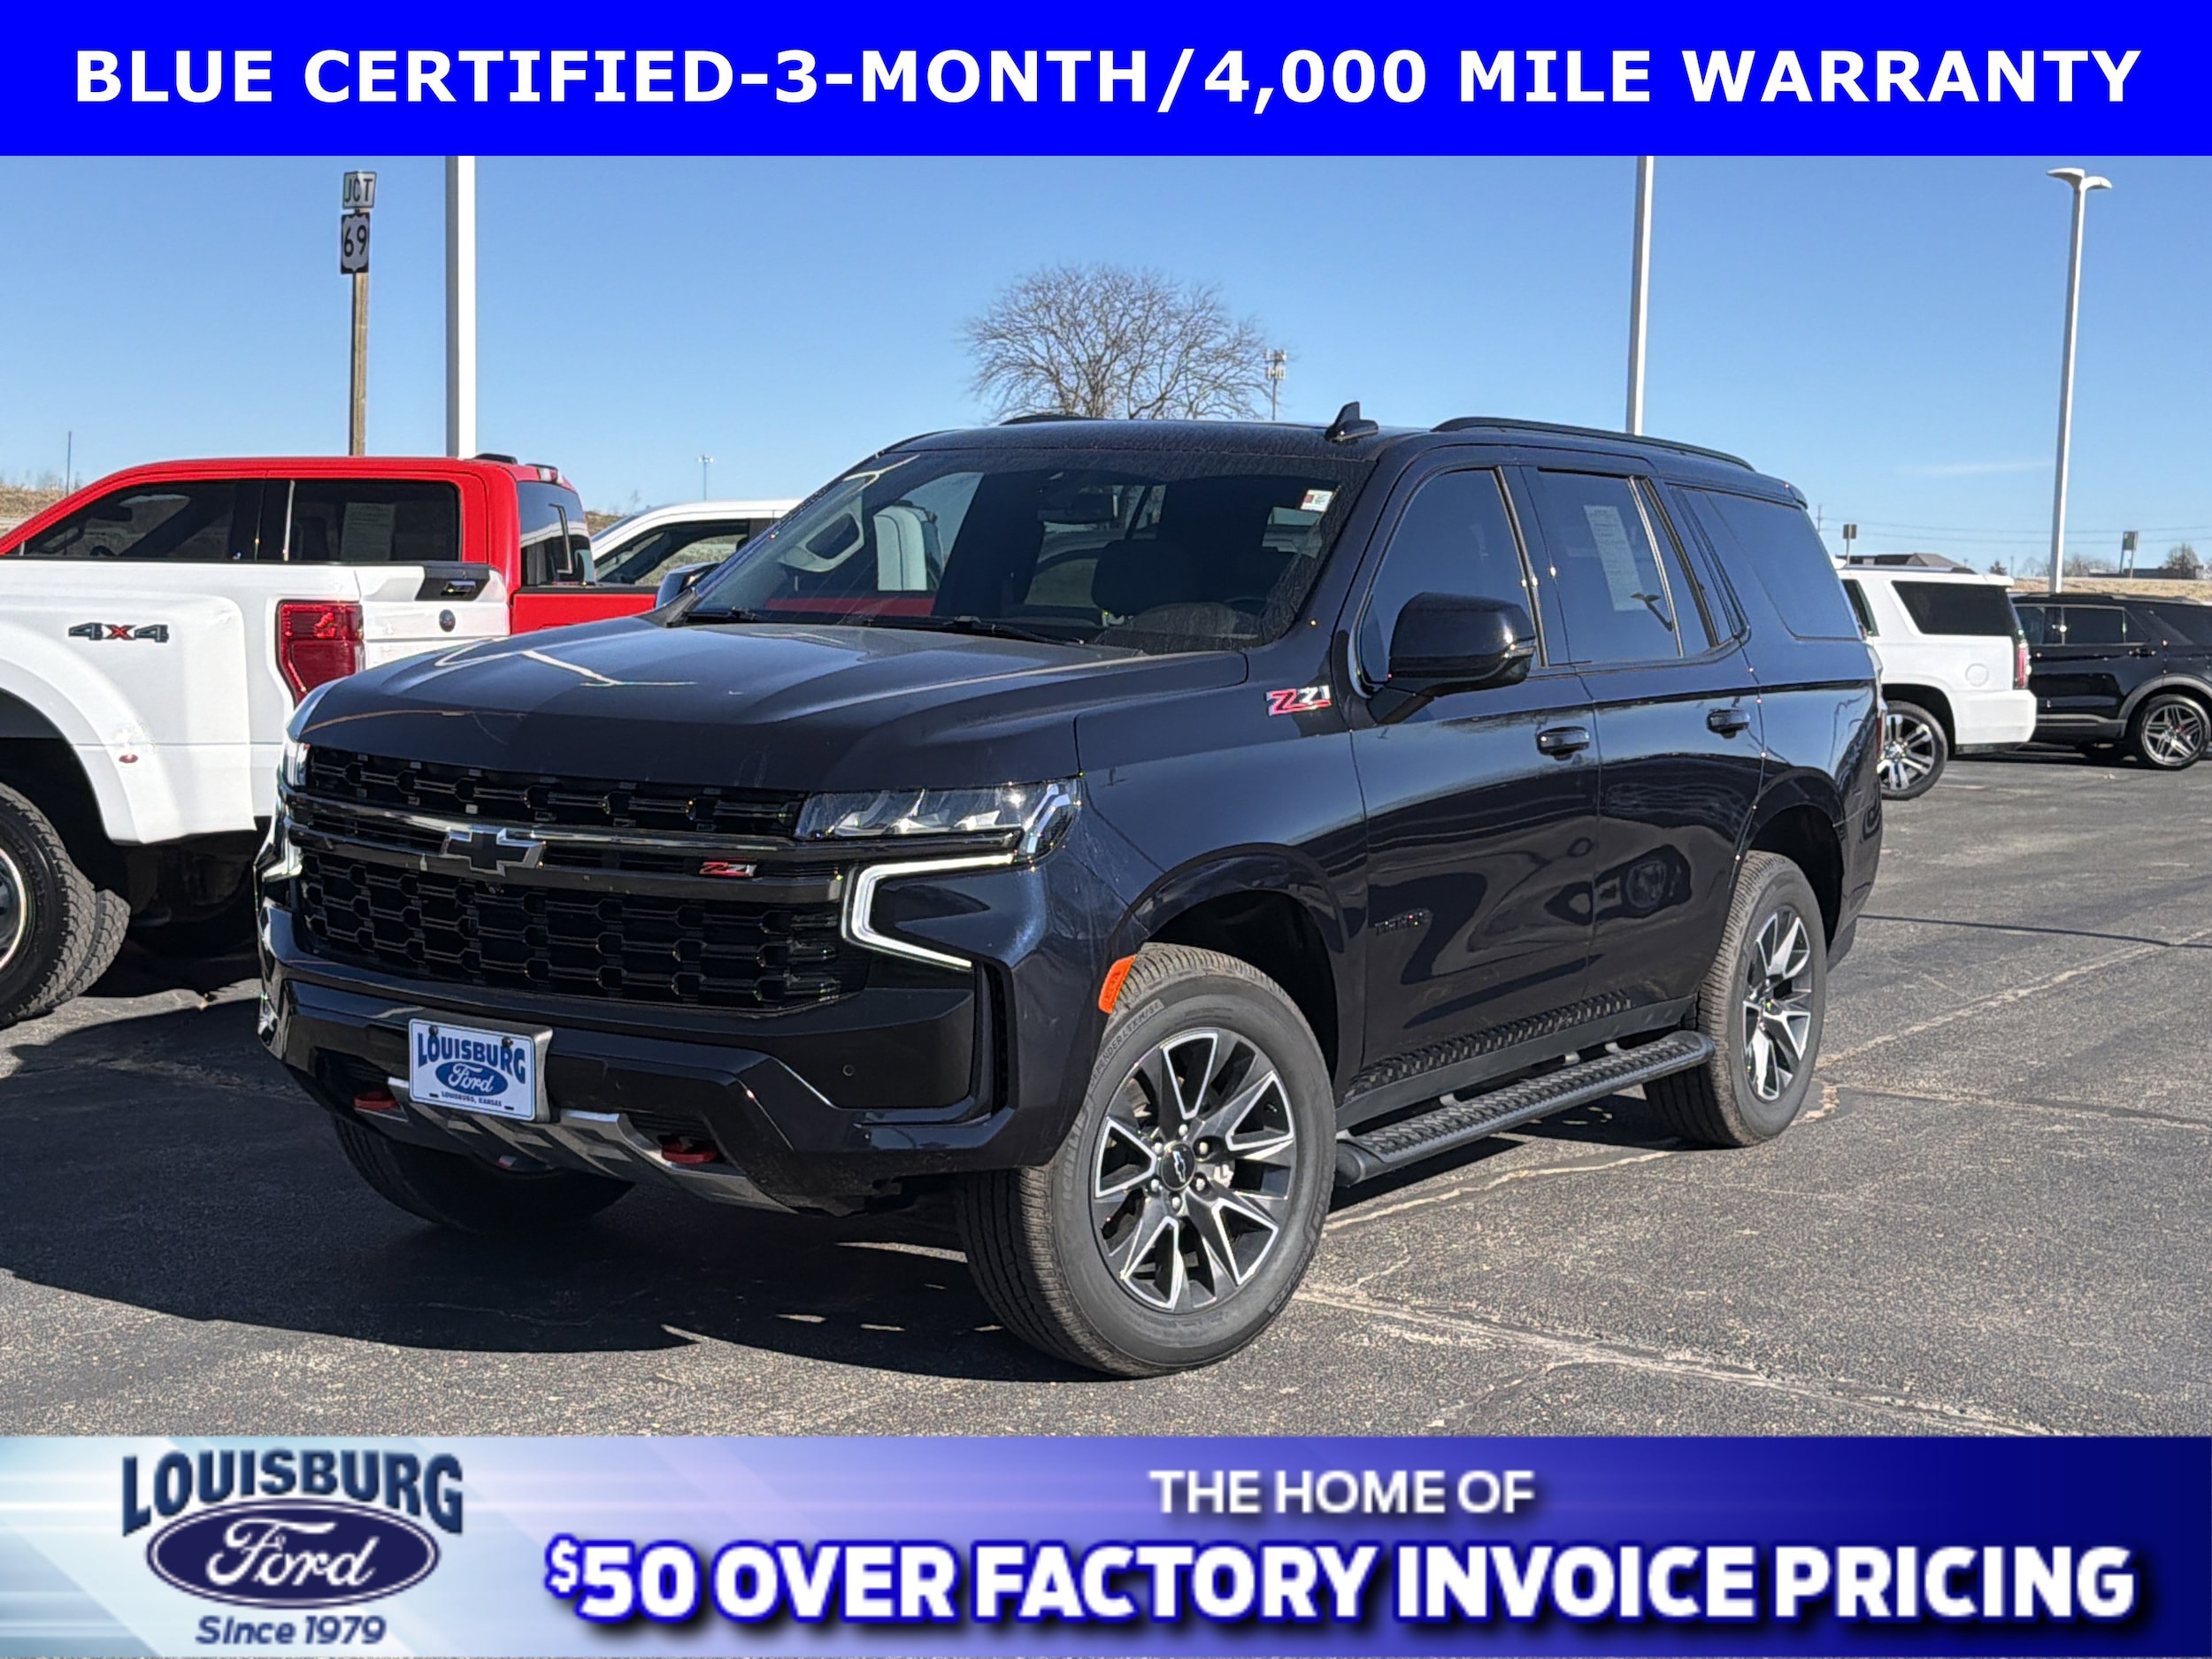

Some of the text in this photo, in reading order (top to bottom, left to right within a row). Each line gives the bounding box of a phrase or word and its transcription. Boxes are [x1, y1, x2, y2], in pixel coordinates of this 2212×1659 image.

[344, 178, 373, 204] JCT
[343, 225, 368, 257] 69
[1263, 685, 1333, 717] Z71
[417, 1032, 526, 1085] LOUISBURG
[447, 1063, 495, 1094] Ford
[441, 1090, 503, 1108] LOUISBURG, KANSAS
